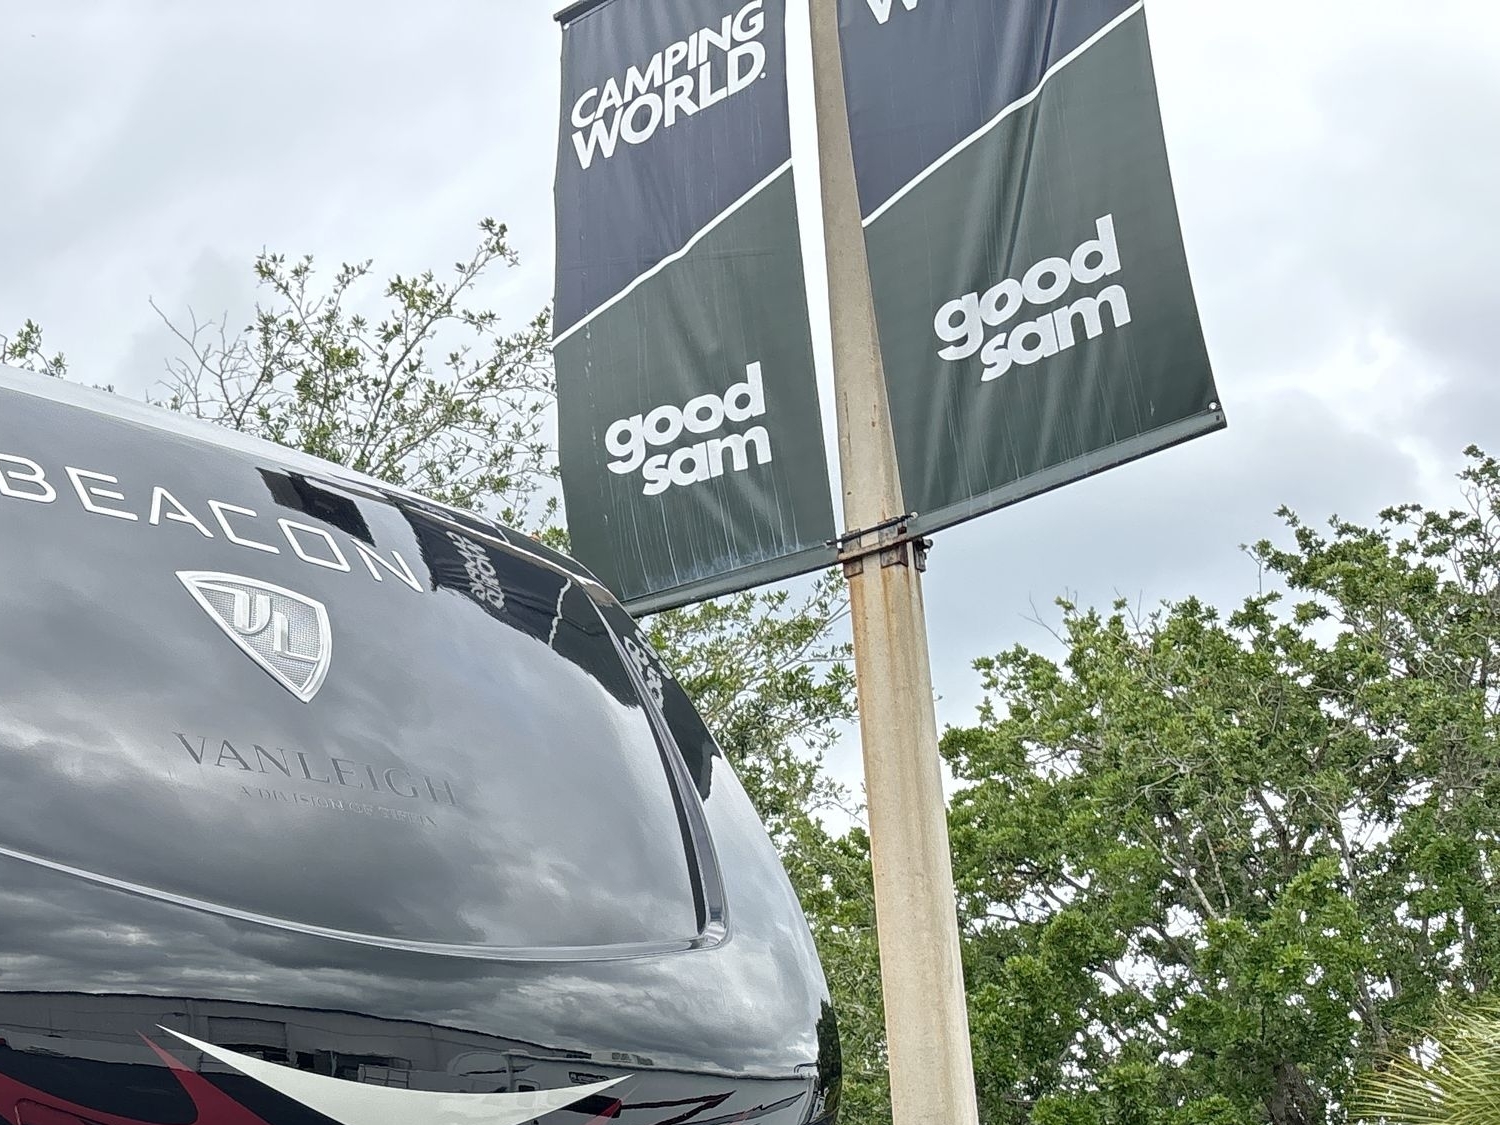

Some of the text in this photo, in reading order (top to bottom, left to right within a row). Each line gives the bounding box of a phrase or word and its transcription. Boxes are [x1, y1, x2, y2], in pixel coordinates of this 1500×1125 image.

[570, 0, 764, 129] CAMPING
[572, 41, 766, 170] WORLD
[933, 214, 1123, 362] good
[980, 285, 1132, 382] sam
[604, 361, 767, 475] good
[642, 426, 772, 496] sam
[172, 731, 457, 807] VANLEIGH
